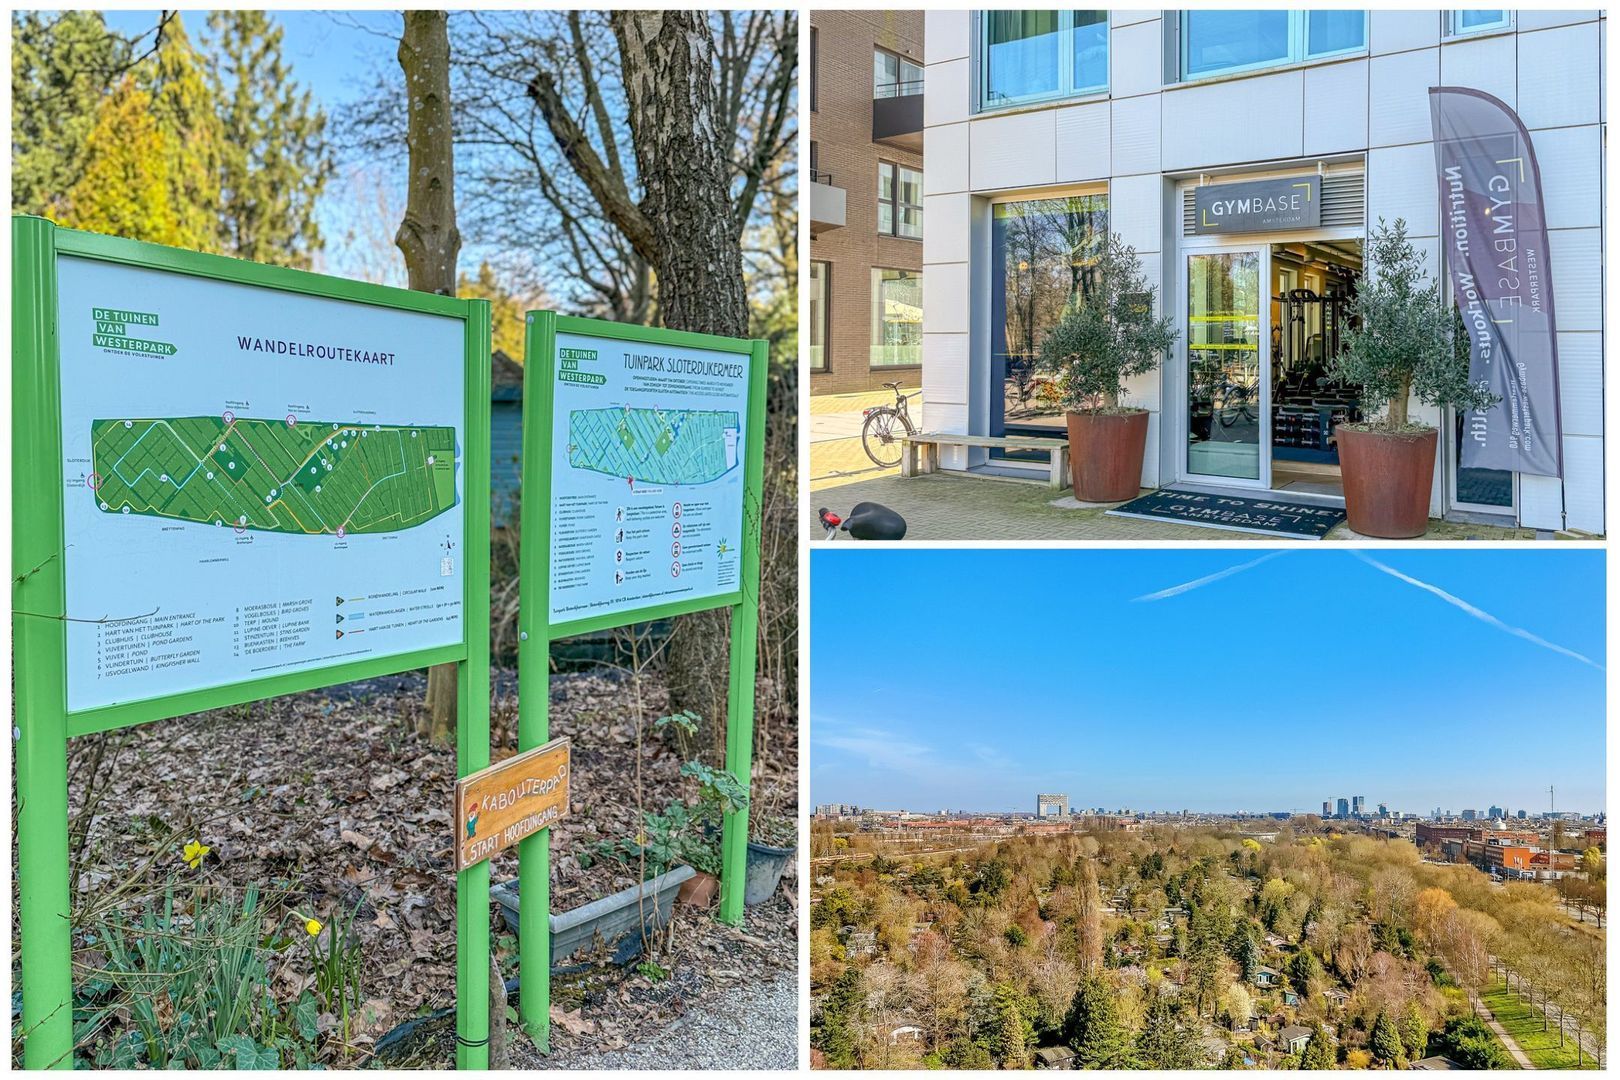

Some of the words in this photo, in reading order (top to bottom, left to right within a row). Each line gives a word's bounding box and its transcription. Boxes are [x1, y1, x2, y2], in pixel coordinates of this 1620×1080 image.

[1211, 194, 1301, 216] GYMBASE
[95, 310, 110, 320] DE
[113, 311, 157, 324] TUINEN
[98, 323, 123, 333] VAN
[95, 336, 173, 354] WESTERPARK
[237, 336, 396, 366] WANDELROUTEKAART
[560, 349, 570, 358] DE
[571, 350, 597, 360] TUINEN
[562, 360, 577, 369] VAN
[623, 353, 665, 372] TUINPARK
[666, 357, 744, 379] SLOTERDIJKERMEER
[560, 371, 604, 384] WESTERPARK
[1156, 489, 1211, 502] TIME
[1217, 498, 1245, 506] TO
[1169, 505, 1284, 523] GYMBASE
[1177, 511, 1281, 527] AMSTERDAM
[169, 612, 196, 620] ENTRANCE
[147, 623, 174, 631] TUINPARK
[105, 635, 134, 645] CLUBHUIS
[168, 635, 193, 644] GARDENS
[105, 658, 144, 669] VLINDERTUIN
[179, 649, 200, 658] GARDEN
[131, 649, 149, 657] POND
[481, 764, 567, 812] KABOUTERPAD
[470, 833, 500, 861] START
[504, 805, 558, 843] HOOFDINGANG
